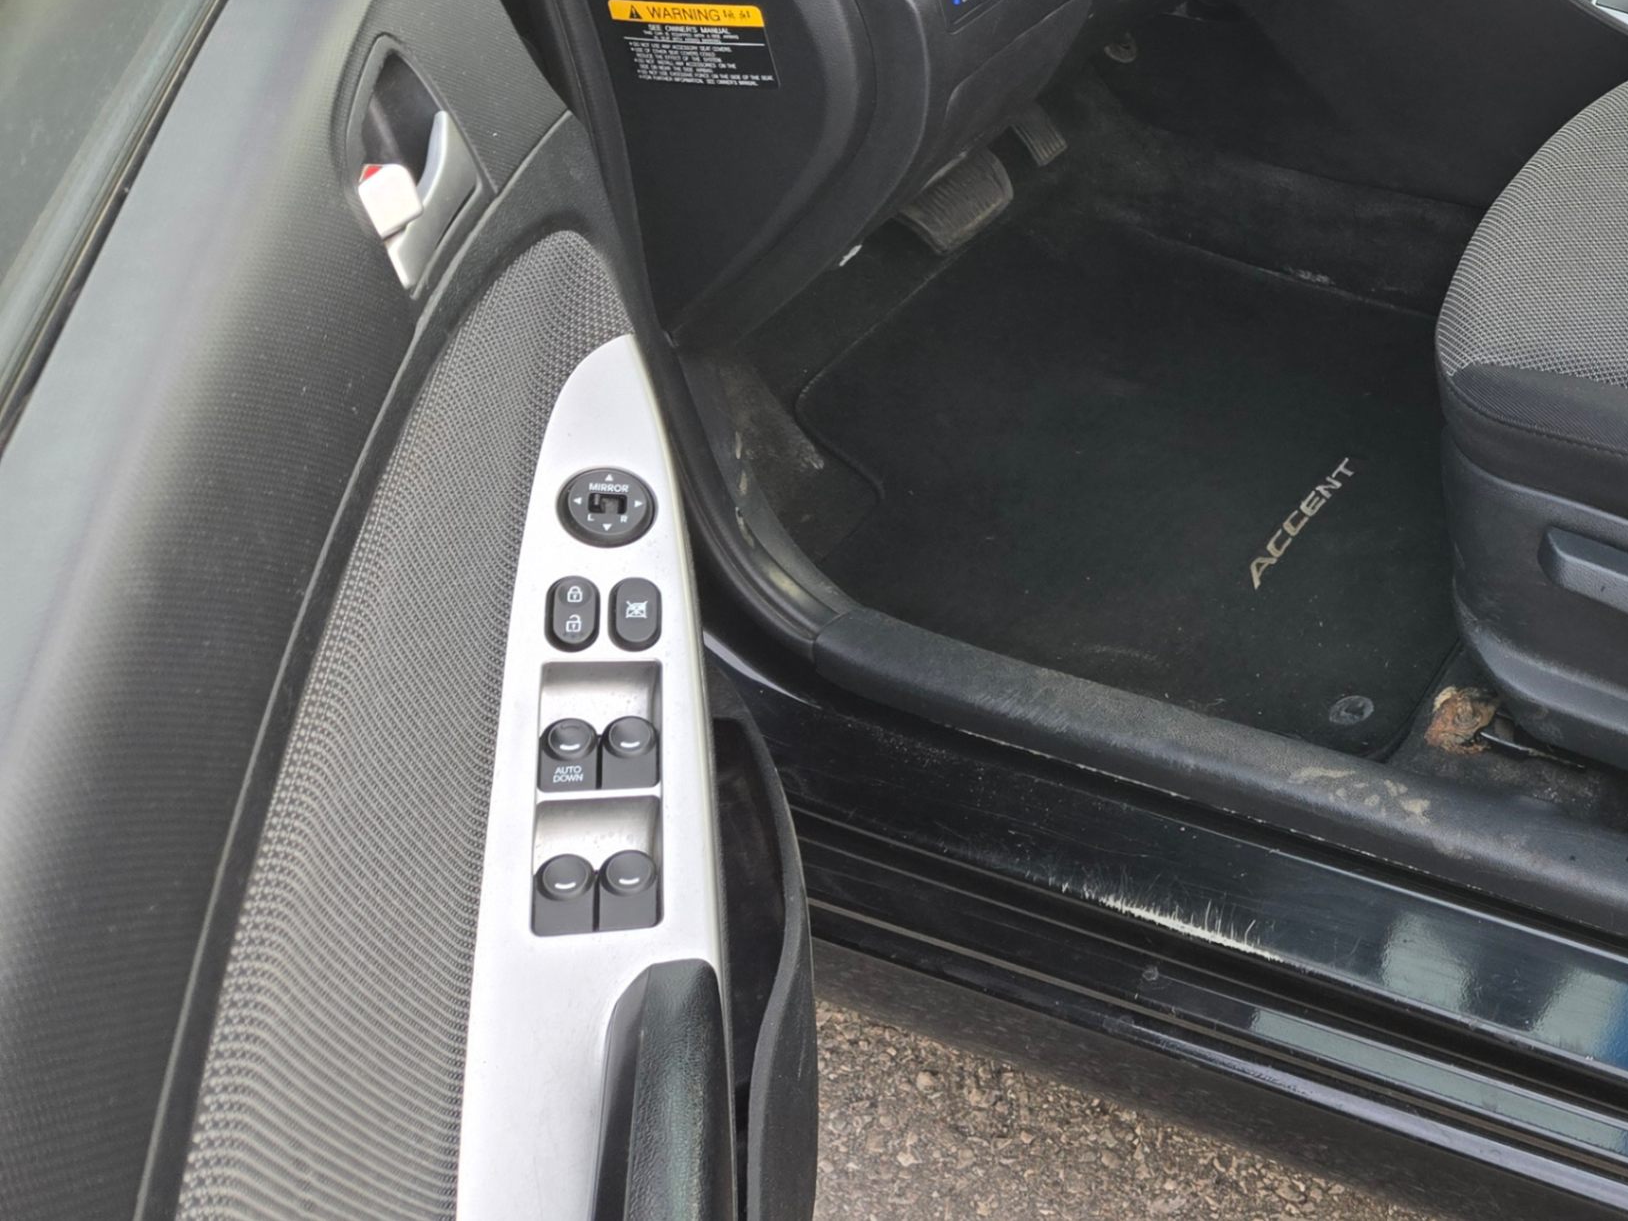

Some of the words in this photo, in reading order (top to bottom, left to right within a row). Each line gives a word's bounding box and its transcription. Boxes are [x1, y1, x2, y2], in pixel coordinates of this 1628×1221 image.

[646, 5, 720, 22] WARNING
[589, 482, 629, 492] MIRROR
[587, 513, 594, 522] L
[620, 514, 628, 523] R
[1249, 457, 1355, 590] ACCENT
[554, 765, 582, 775] AUTO
[552, 774, 584, 783] DOWN
